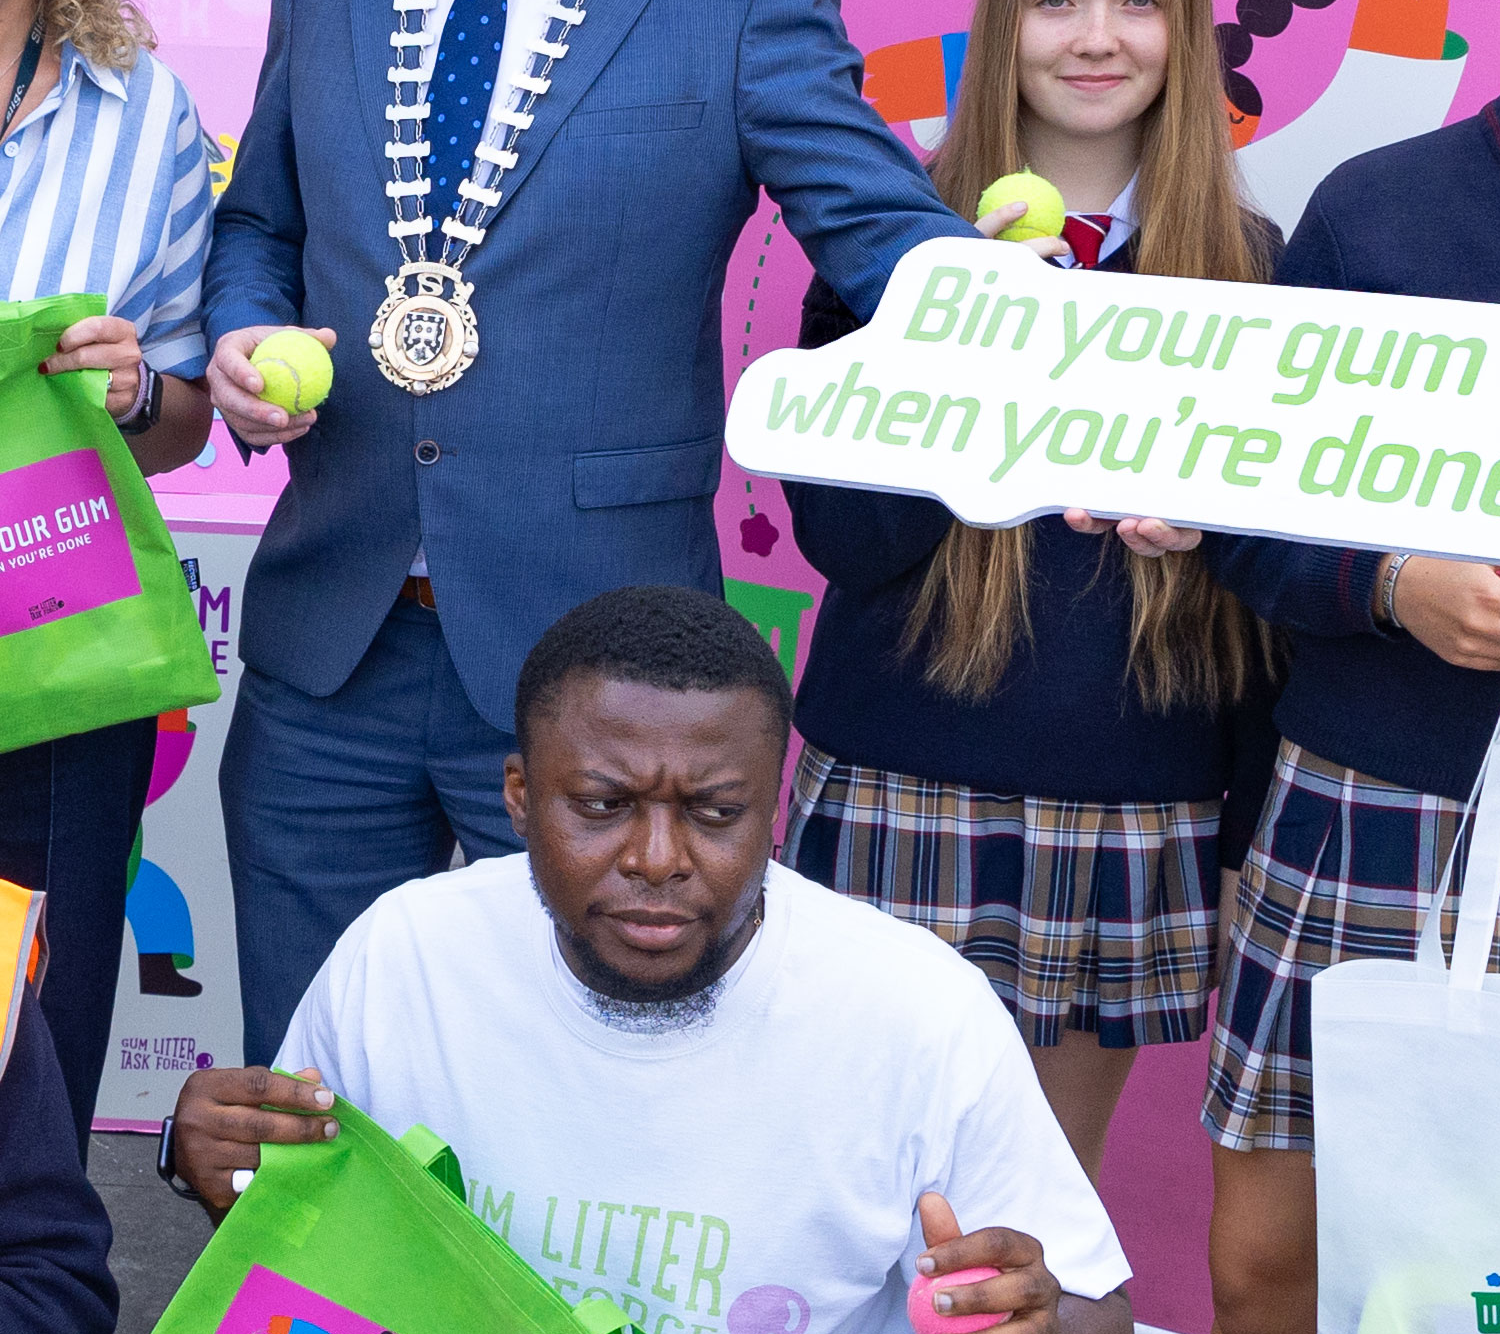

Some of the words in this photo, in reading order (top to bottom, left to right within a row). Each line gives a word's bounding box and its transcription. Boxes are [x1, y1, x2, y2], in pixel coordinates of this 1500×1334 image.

[904, 265, 1041, 353] Bin
[1049, 297, 1273, 380] your
[1271, 320, 1488, 406] gum
[766, 360, 982, 453] when
[989, 395, 1282, 482] you're
[55, 495, 111, 536] GUM
[7, 546, 55, 574] YOU'RE
[56, 532, 93, 559] DONE
[120, 1050, 151, 1070] TASK
[156, 1057, 195, 1071] FORCE
[121, 1038, 148, 1051] GUM
[153, 1037, 196, 1061] LITTER
[541, 1196, 731, 1318] LITTER
